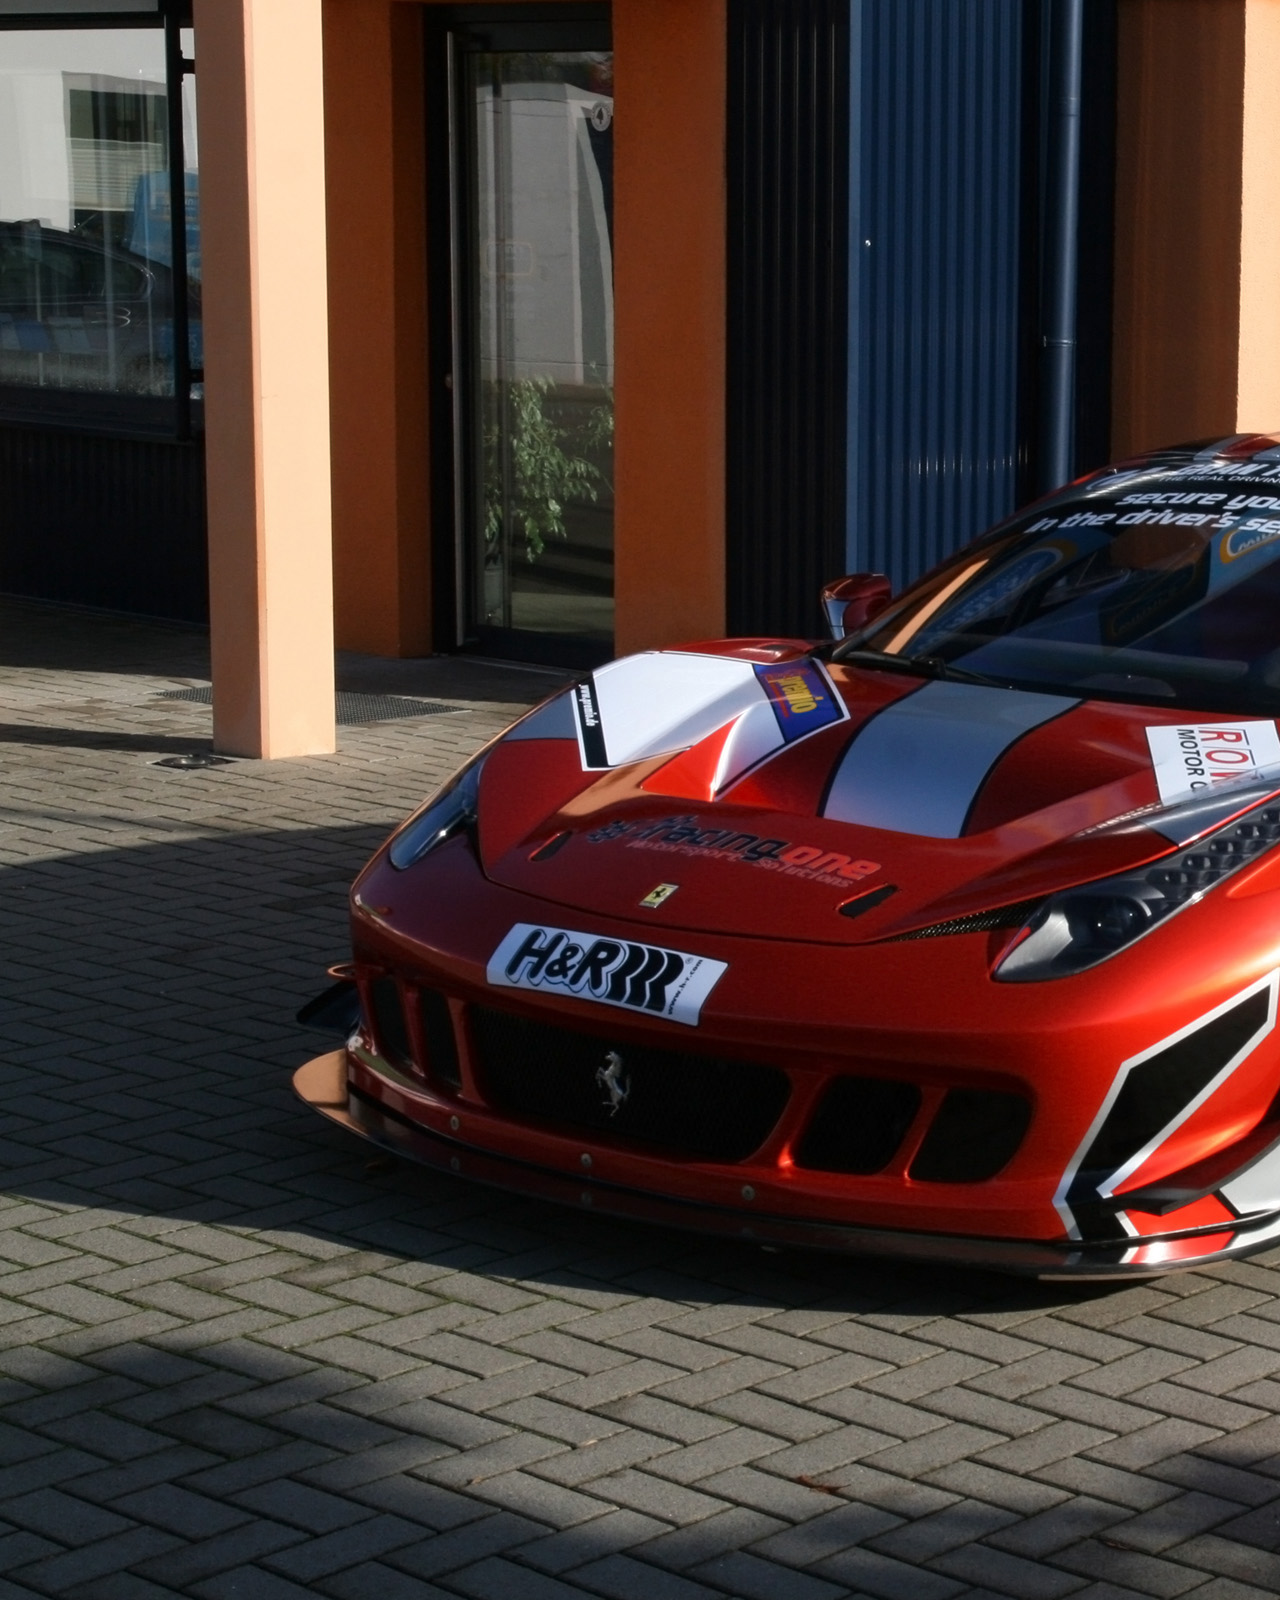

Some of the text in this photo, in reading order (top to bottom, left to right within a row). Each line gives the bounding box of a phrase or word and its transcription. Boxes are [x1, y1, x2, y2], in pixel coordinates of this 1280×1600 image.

[1160, 475, 1185, 483] THE
[1177, 463, 1269, 476] GRAN
[1115, 492, 1228, 506] secure
[1023, 517, 1059, 534] in
[1057, 511, 1117, 529] the
[1115, 508, 1241, 529] driver's
[768, 676, 825, 714] premio
[1176, 728, 1205, 777] MOTOR
[506, 928, 626, 997] H&R
[668, 959, 704, 1015] www.h-r.com
